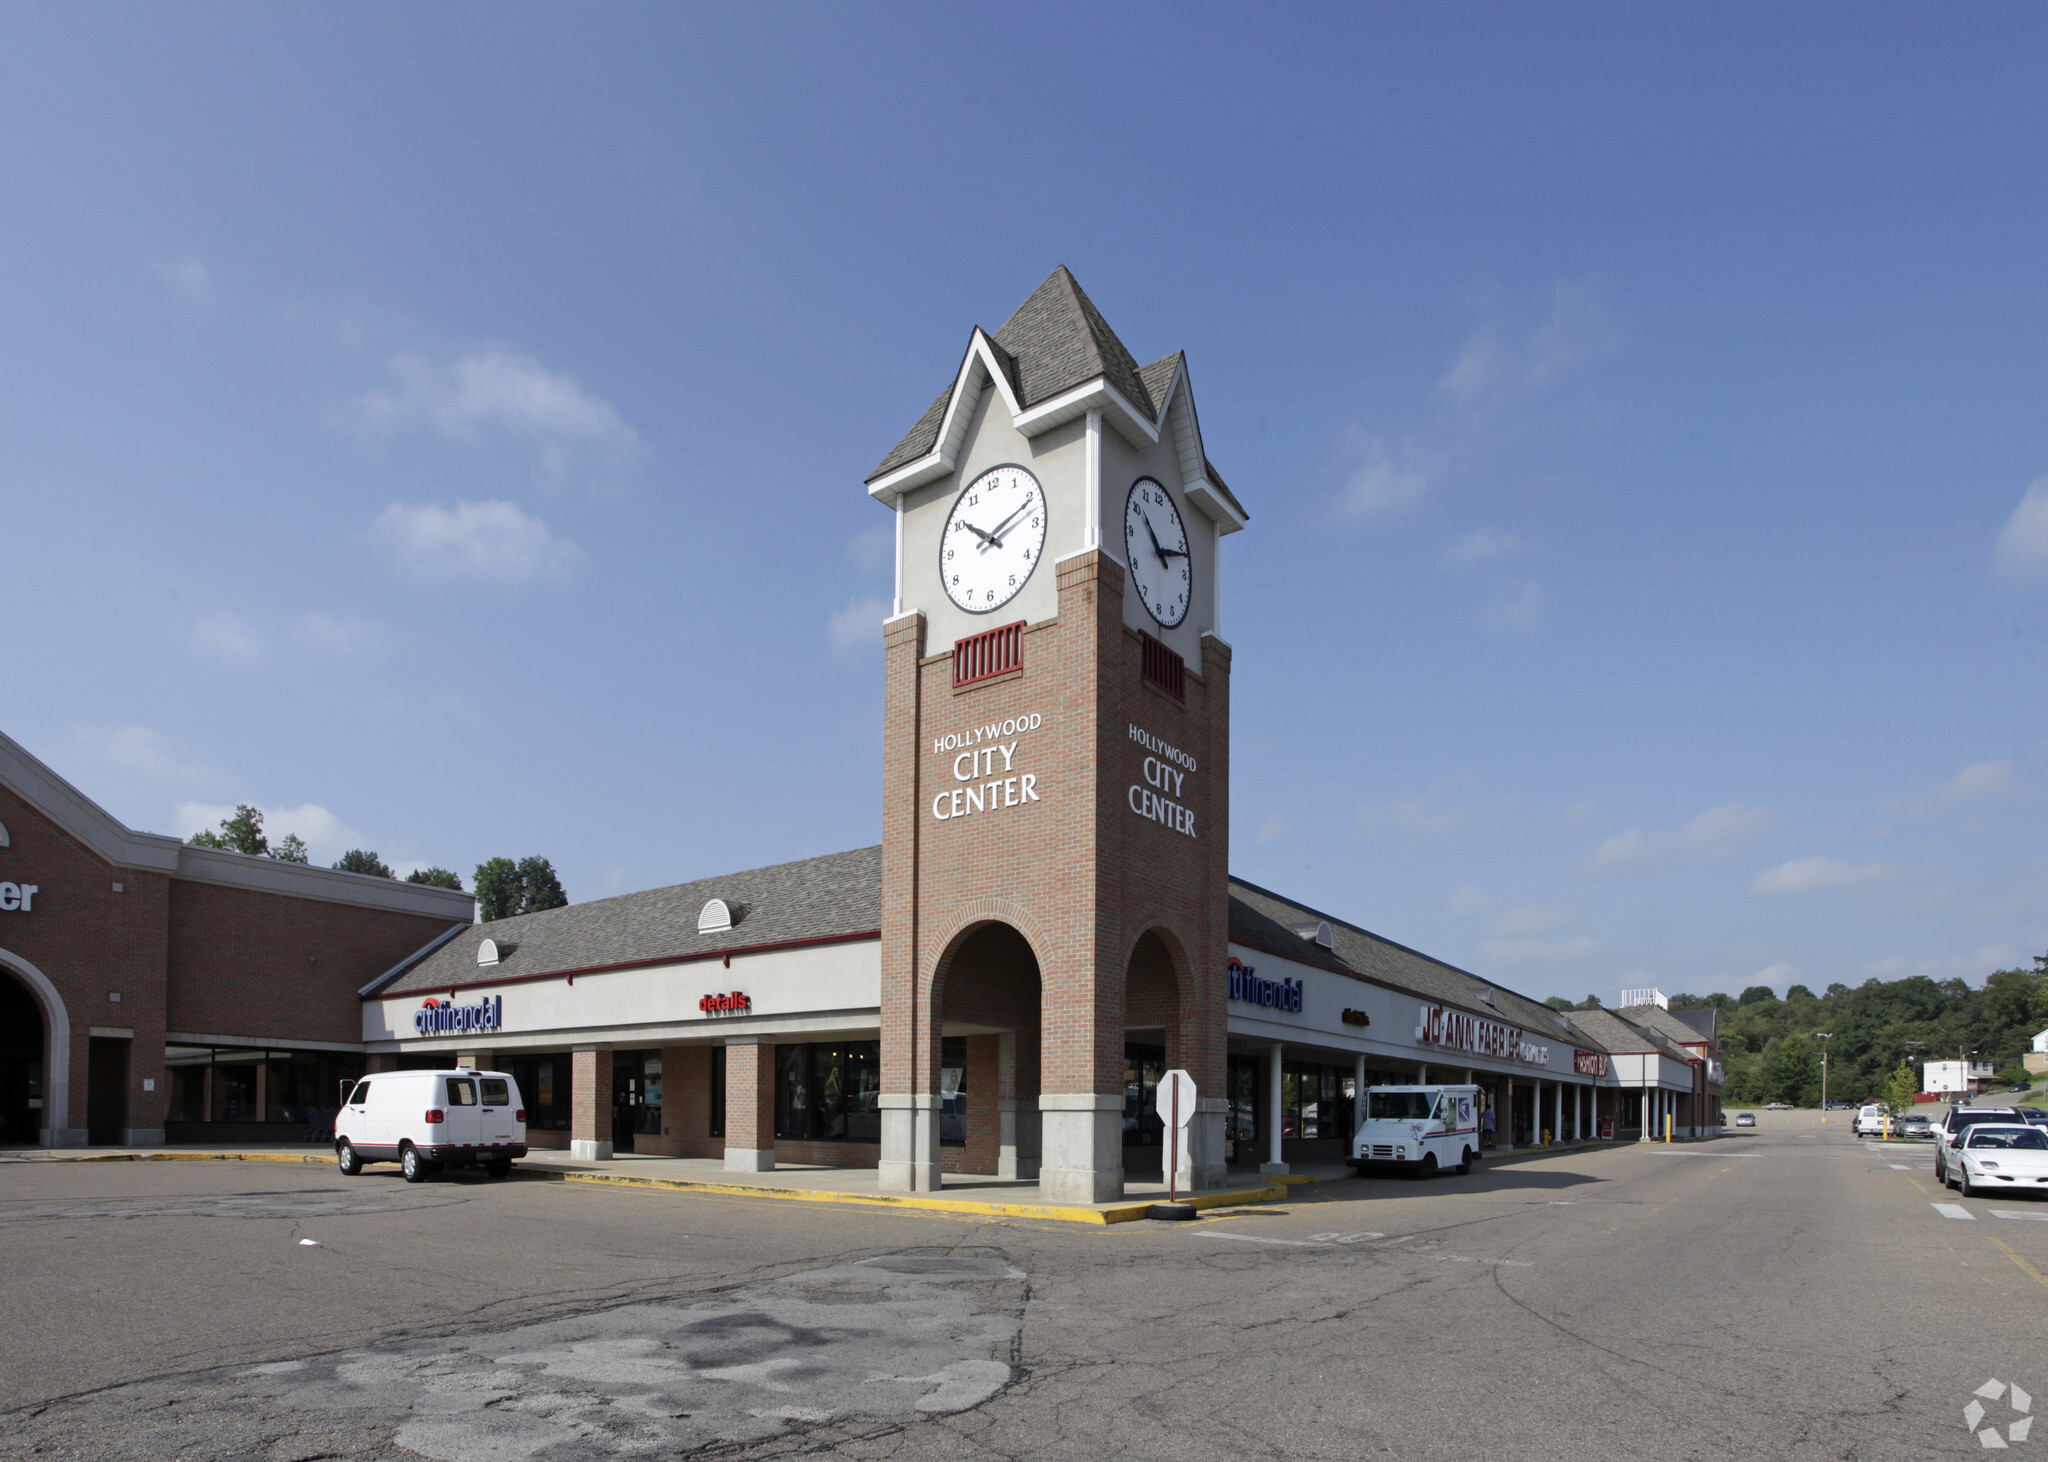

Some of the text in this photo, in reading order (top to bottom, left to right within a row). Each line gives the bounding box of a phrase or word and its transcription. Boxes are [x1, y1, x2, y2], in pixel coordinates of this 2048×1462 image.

[987, 477, 1000, 492] 12
[1012, 477, 1018, 489] 1
[968, 494, 980, 507] 11
[1026, 492, 1034, 502] 2
[1142, 490, 1150, 504] 11
[1154, 492, 1164, 506] 12
[1132, 502, 1140, 516] 10
[1032, 517, 1039, 528] 3
[1170, 514, 1175, 524] 1
[954, 520, 966, 533] 10
[1128, 525, 1134, 536] 9
[1178, 540, 1184, 551] 2
[948, 550, 954, 560] 9
[1023, 549, 1030, 560] 4
[1132, 558, 1138, 570] 8
[952, 574, 960, 586] 8
[1008, 574, 1016, 586] 5
[1182, 570, 1187, 580] 3
[966, 590, 974, 600] 7
[986, 590, 994, 602] 6
[1142, 586, 1148, 596] 7
[1178, 593, 1183, 604] 4
[1156, 604, 1162, 614] 6
[1170, 605, 1174, 616] 5
[934, 713, 1041, 754] HOLLYWOOD
[1129, 723, 1196, 772] HOLLYWOOD
[953, 741, 1018, 782] CITY
[1144, 756, 1184, 798] CITY
[932, 774, 1040, 820] CENTER
[1128, 784, 1196, 838] CENTER
[699, 991, 748, 1012] details
[1475, 1020, 1522, 1060] FABRICS
